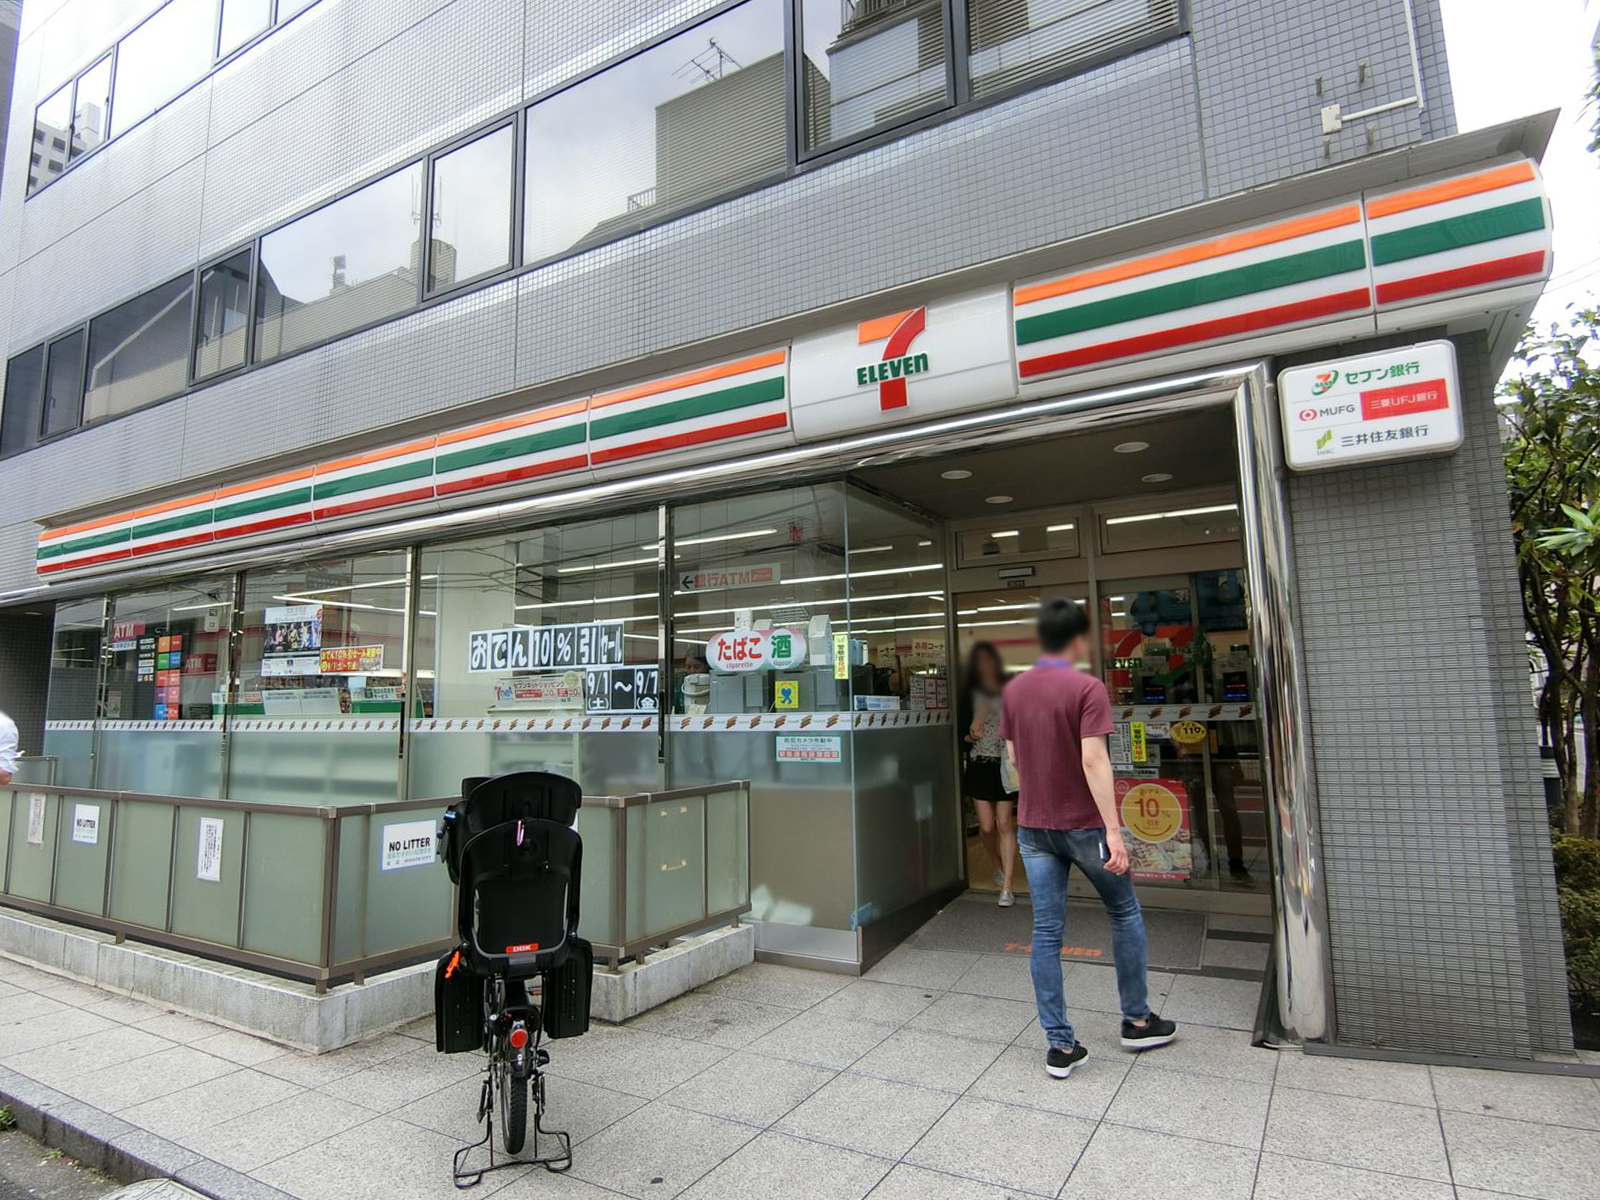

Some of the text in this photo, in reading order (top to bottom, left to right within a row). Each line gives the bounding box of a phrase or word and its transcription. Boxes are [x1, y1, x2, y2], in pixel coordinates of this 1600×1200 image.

[858, 306, 926, 411] 7
[1371, 391, 1438, 410] 三菱UFJ銀行
[1319, 405, 1355, 417] MUFG
[1341, 425, 1429, 448] 三井住友銀行
[113, 623, 134, 639] ATM
[718, 636, 762, 661] たばこ
[771, 634, 791, 658] 酒
[185, 658, 202, 669] ATM
[726, 661, 753, 669] cigarette
[389, 837, 431, 852] NO LITTER
